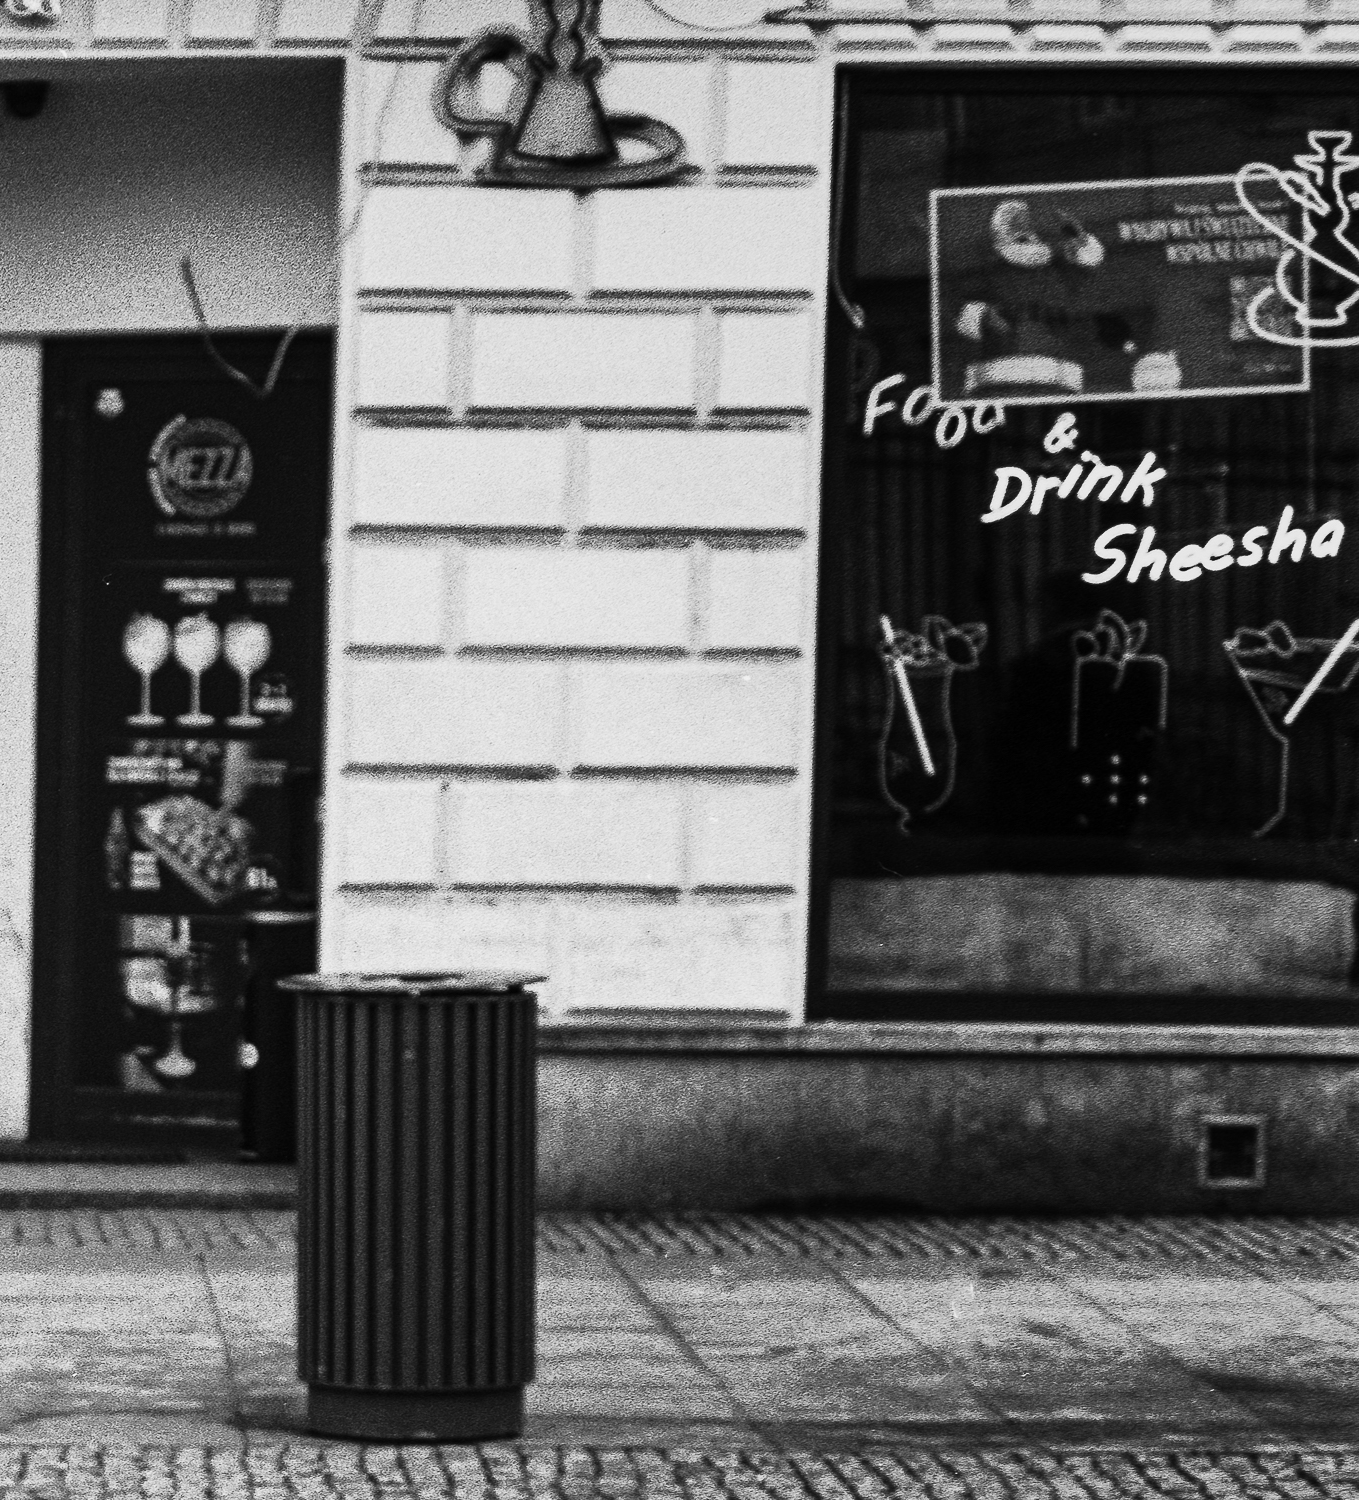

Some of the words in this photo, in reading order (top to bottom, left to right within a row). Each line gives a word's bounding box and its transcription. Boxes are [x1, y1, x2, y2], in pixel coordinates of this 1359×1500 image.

[1043, 411, 1079, 454] &
[980, 450, 1168, 524] Drink
[1082, 505, 1346, 585] Sheesha
